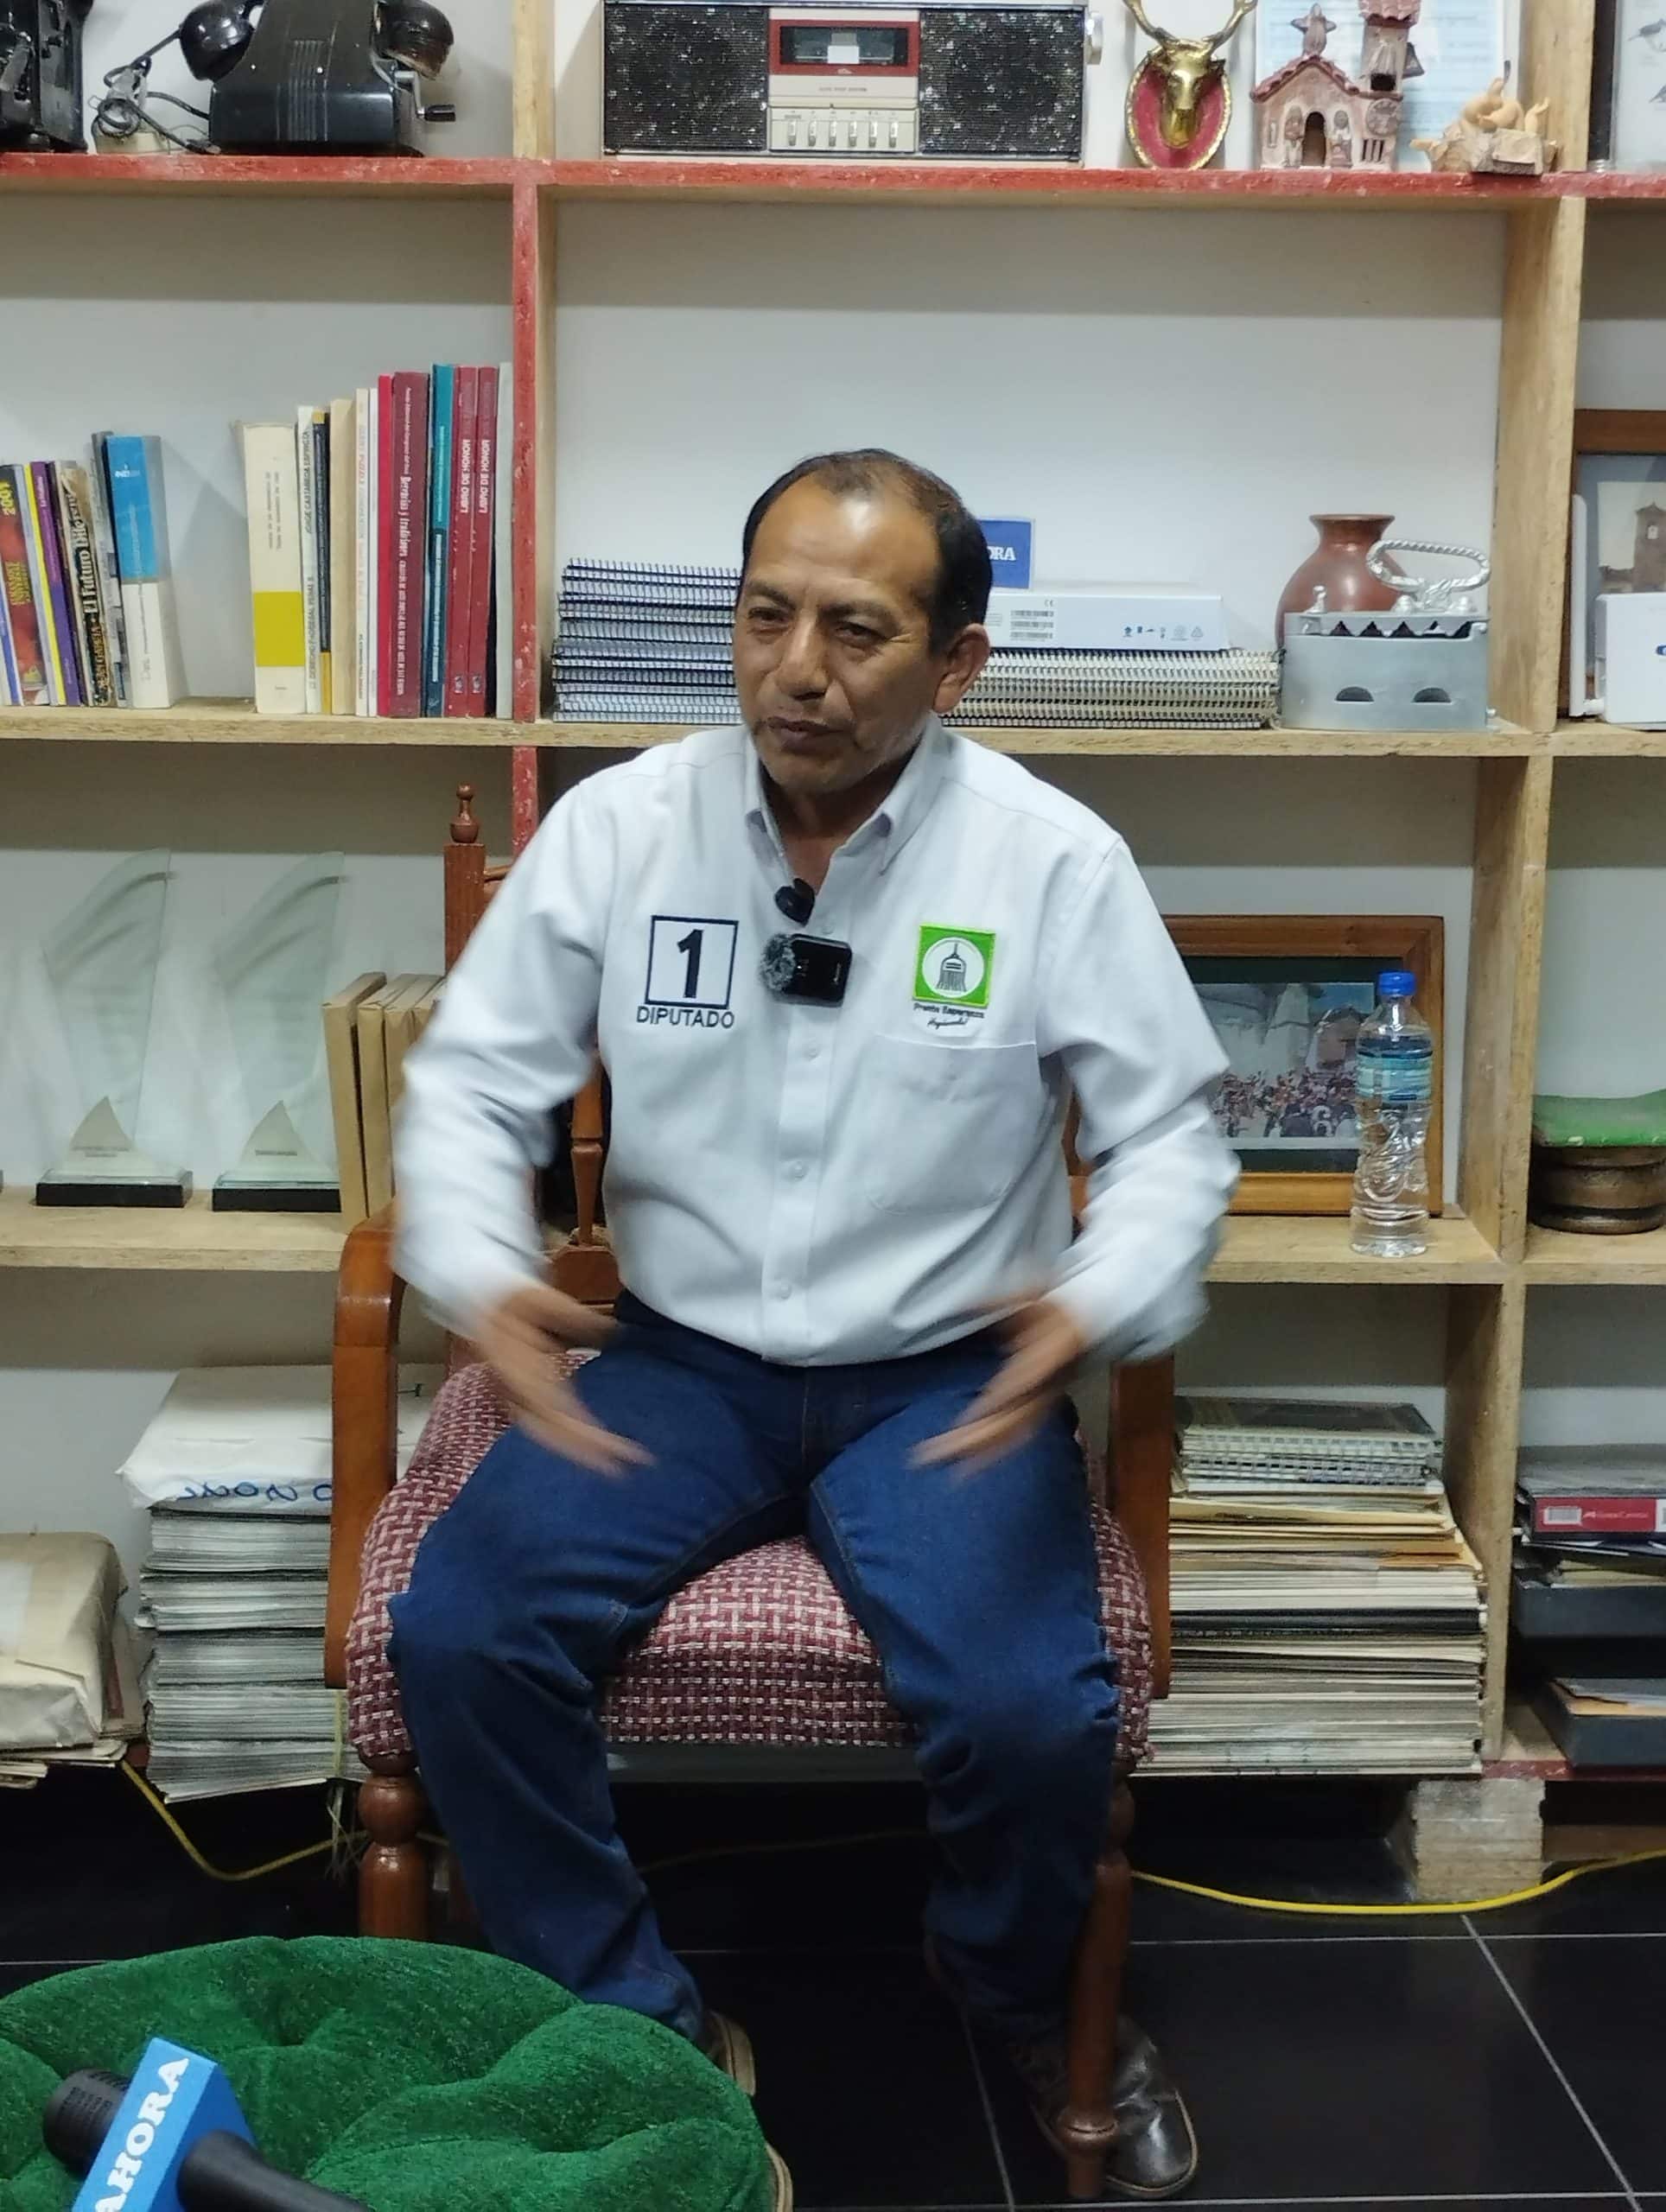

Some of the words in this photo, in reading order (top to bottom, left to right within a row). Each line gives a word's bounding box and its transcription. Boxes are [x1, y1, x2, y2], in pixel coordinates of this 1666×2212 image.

[461, 439, 472, 473] HONOR
[480, 439, 492, 473] HONOR
[461, 473, 470, 486] DE
[480, 474, 490, 486] DE
[460, 486, 471, 513] LIBRO
[478, 486, 490, 513] LIBRO
[79, 550, 99, 597] Futuro
[677, 929, 704, 998] 1
[636, 1005, 735, 1029] DIPUTADO
[95, 2057, 190, 2212] AHORA
